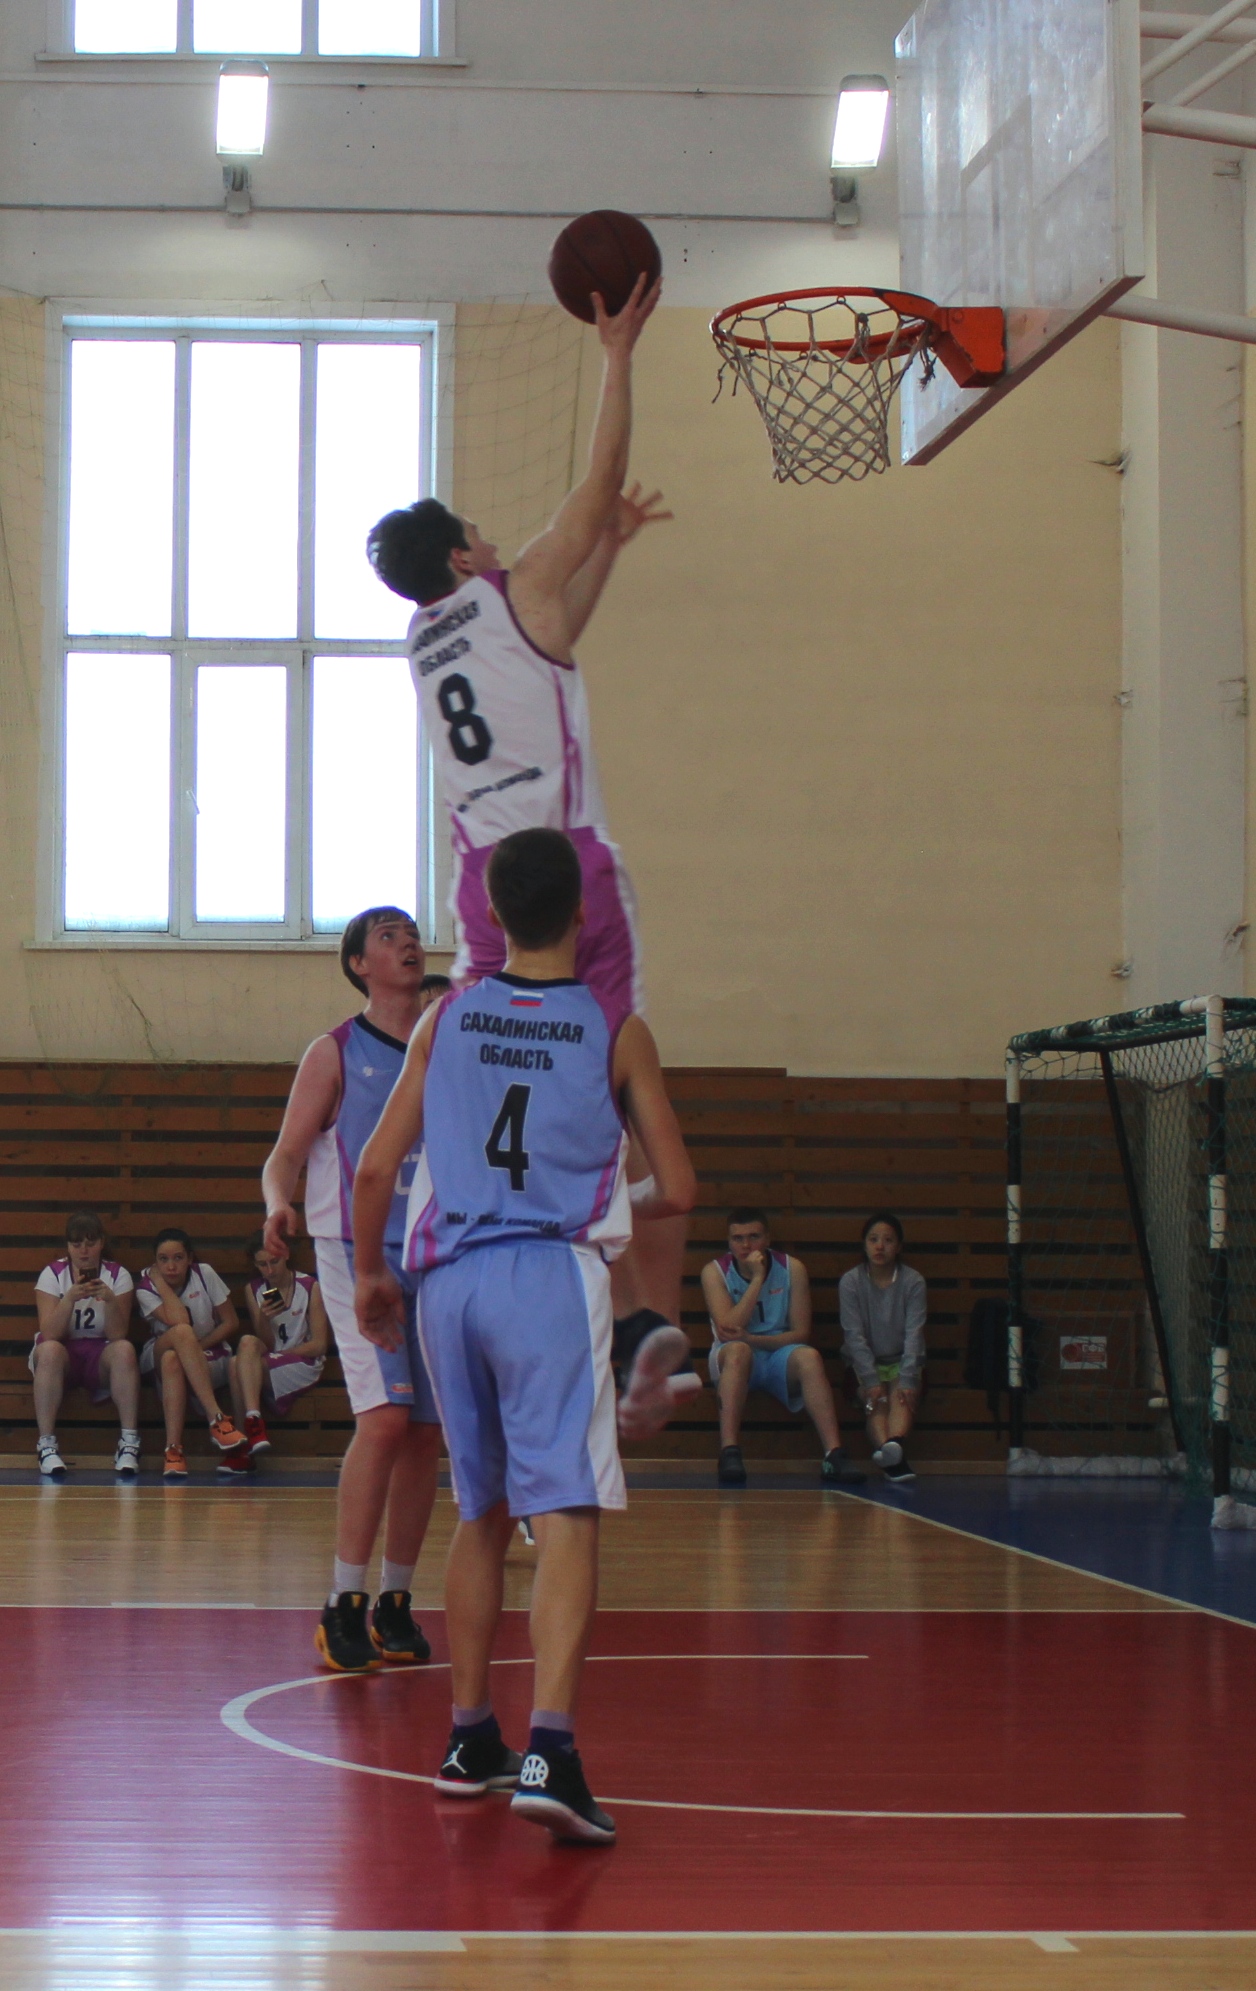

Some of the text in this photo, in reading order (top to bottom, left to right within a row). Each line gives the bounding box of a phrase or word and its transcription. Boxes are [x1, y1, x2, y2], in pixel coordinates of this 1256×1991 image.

[438, 672, 493, 766] 8
[460, 1011, 585, 1044] САХАЛИНСКАЯ
[479, 1043, 554, 1071] ОБЛАСТЬ
[485, 1082, 532, 1192] 4
[75, 1307, 96, 1330] 12
[278, 1322, 288, 1343] 4
